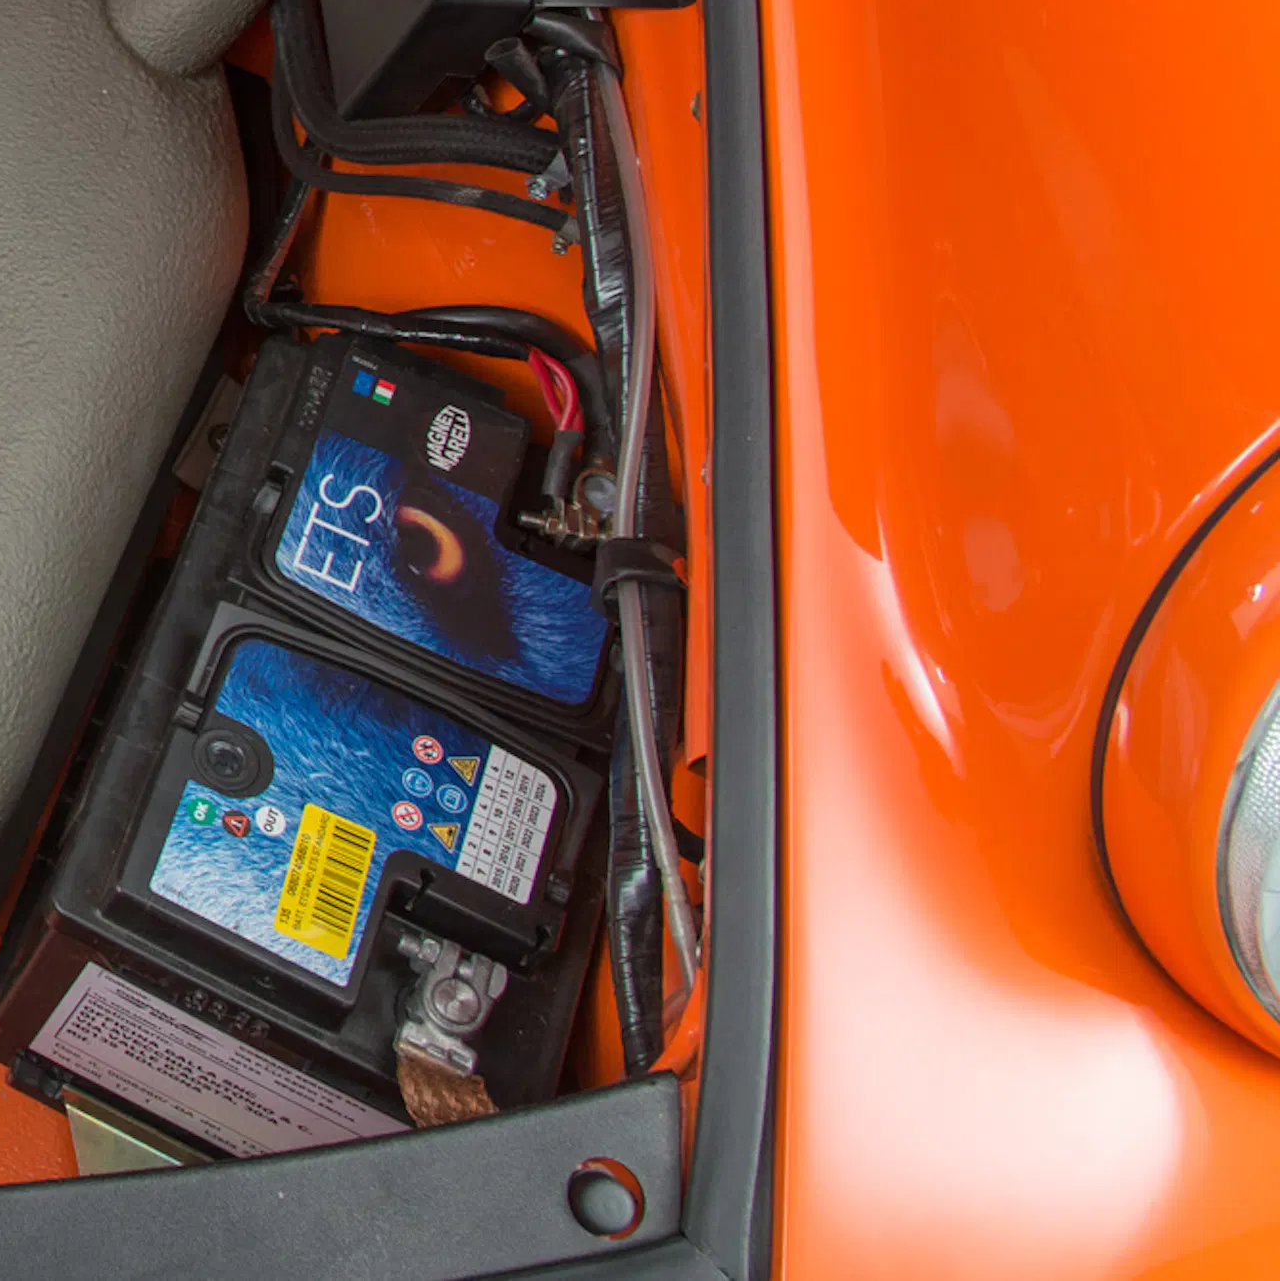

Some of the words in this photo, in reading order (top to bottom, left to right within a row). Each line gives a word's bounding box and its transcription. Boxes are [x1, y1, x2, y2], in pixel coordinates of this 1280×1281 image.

[426, 404, 456, 471] MAGNETI
[293, 473, 383, 592] ETS
[517, 774, 531, 794] 2019
[193, 801, 210, 821] OK
[263, 808, 278, 832] OUT
[510, 796, 525, 817] 2018
[504, 819, 518, 841] 2017
[73, 1015, 102, 1032] VIA
[107, 1033, 158, 1062] VALLE
[80, 1005, 160, 1048] OFFICINA
[163, 1047, 219, 1079] DALLA
[122, 1049, 203, 1093] BOLOGNA
[198, 1073, 275, 1116] ANTONIO
